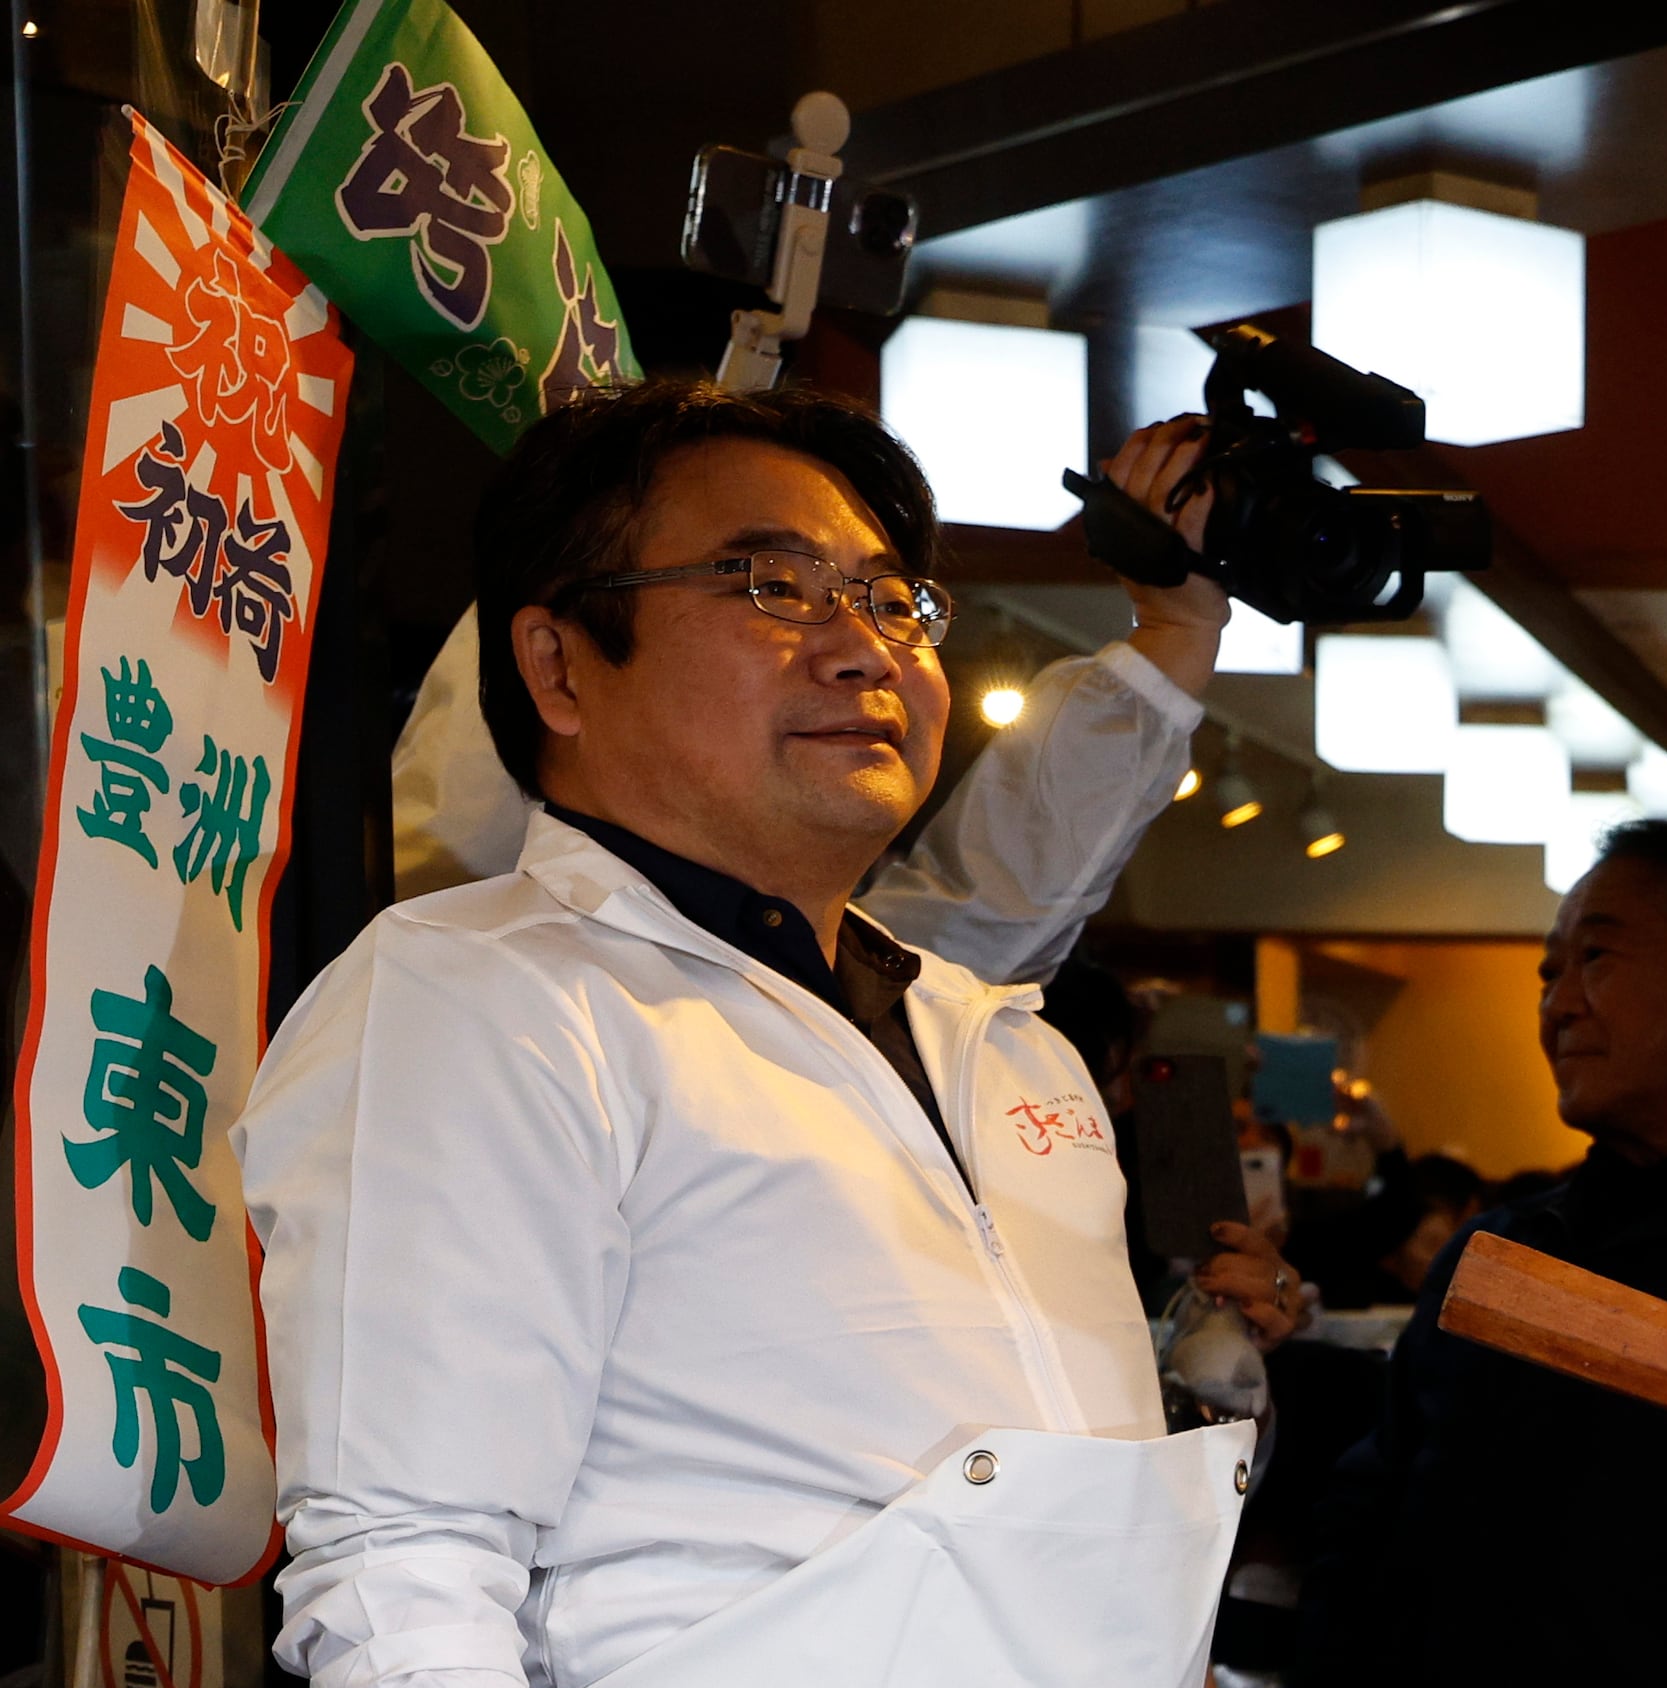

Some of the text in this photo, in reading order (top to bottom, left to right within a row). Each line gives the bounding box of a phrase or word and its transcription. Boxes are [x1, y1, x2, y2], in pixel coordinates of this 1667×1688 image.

[166, 247, 292, 473] 祝
[115, 421, 293, 683] 初荷
[76, 653, 271, 933] 豊洲
